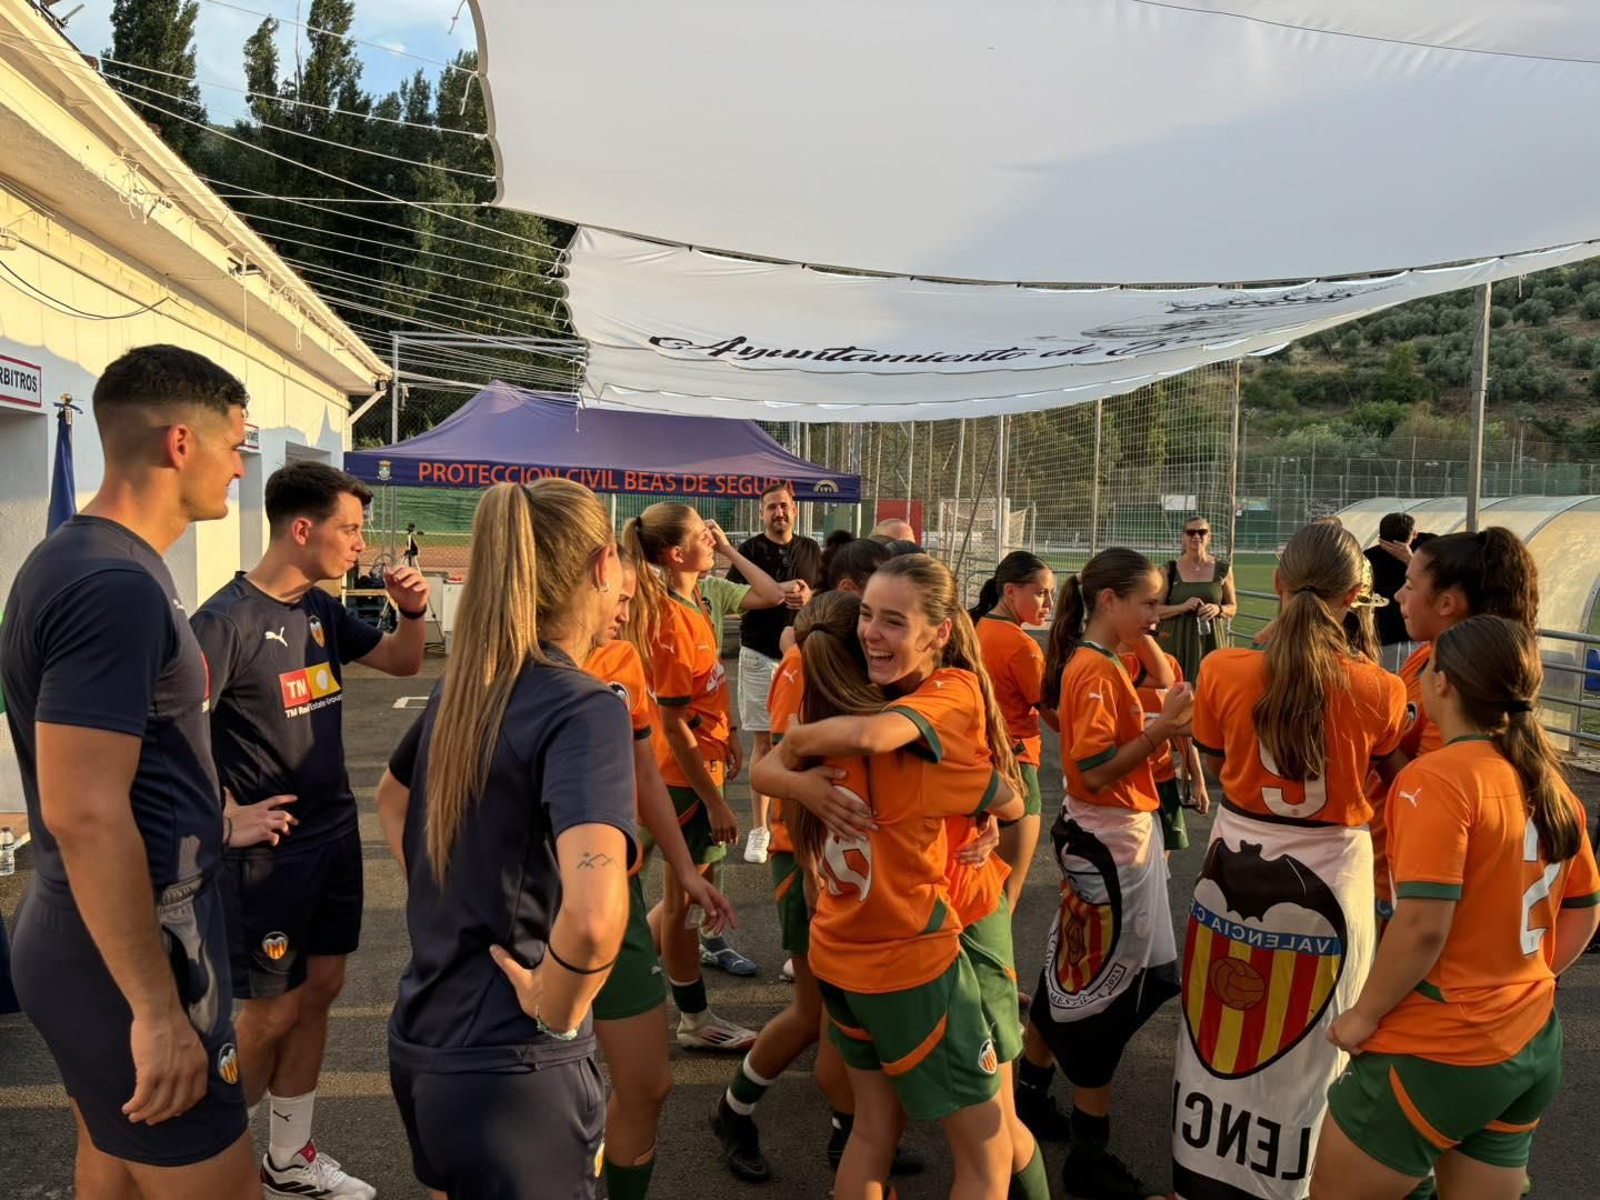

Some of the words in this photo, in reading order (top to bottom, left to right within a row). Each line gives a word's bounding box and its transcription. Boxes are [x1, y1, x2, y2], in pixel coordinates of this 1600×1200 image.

[649, 336, 1036, 362] Ayuntamiento
[418, 462, 559, 486] PROTECCION
[566, 469, 620, 489] CIVIL
[624, 471, 677, 491] BEAS
[682, 474, 710, 492] DE
